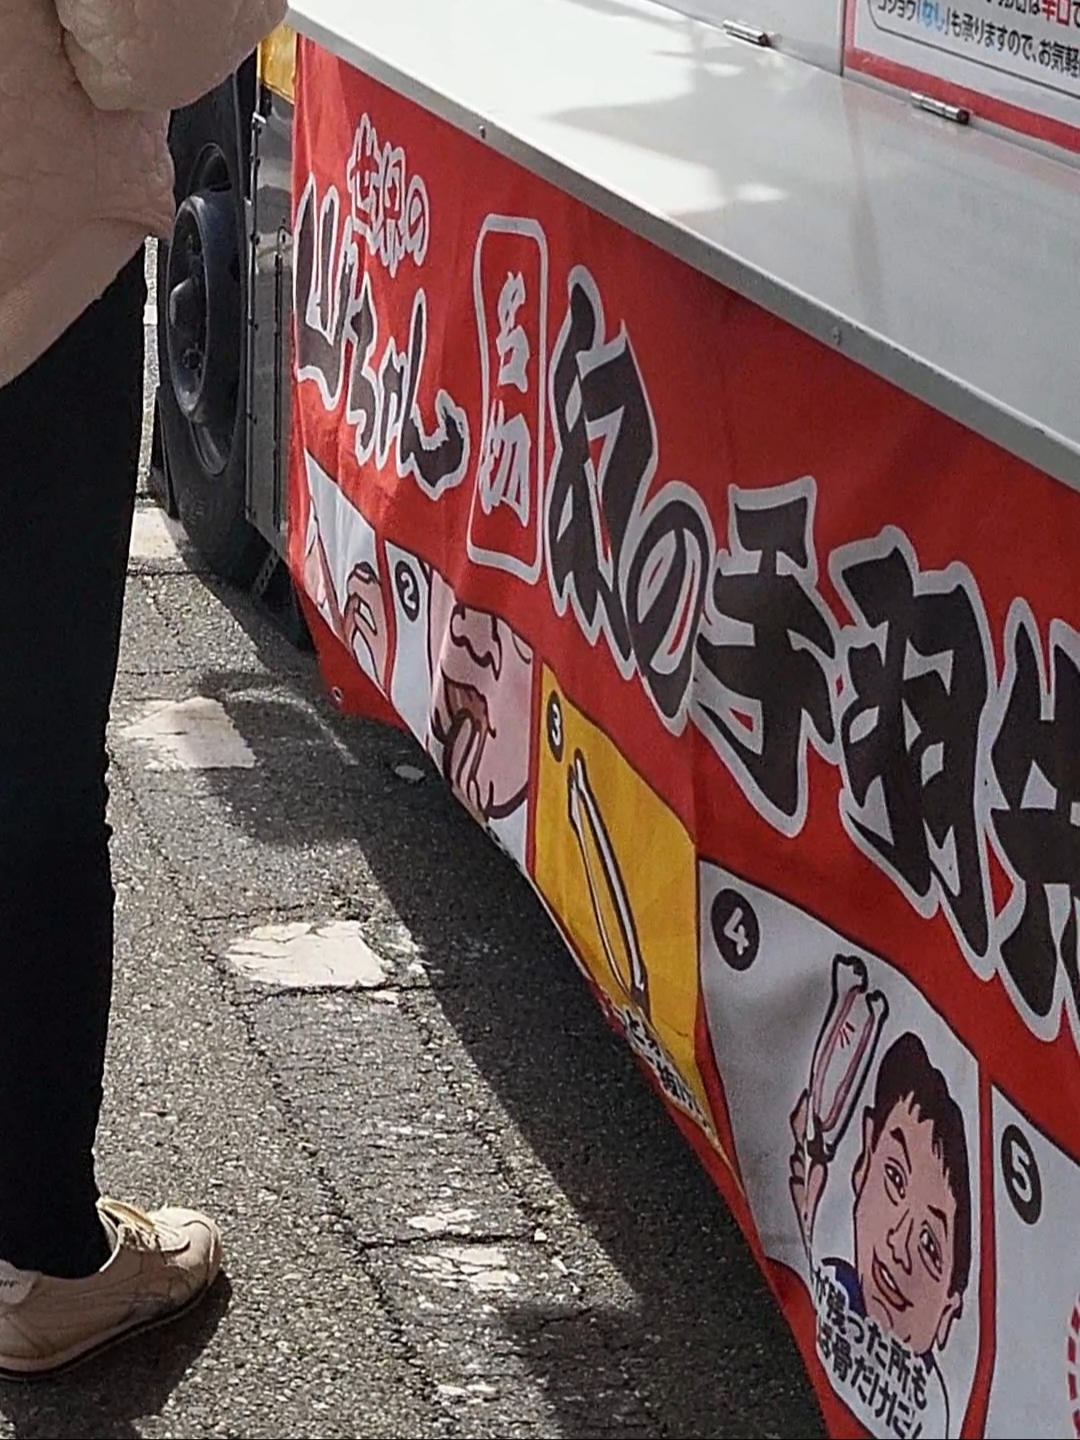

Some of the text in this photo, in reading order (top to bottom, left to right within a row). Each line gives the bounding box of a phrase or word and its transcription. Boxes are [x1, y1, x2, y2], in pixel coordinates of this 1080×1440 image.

[347, 112, 429, 278] 世界の
[292, 170, 471, 500] 山ちゃん
